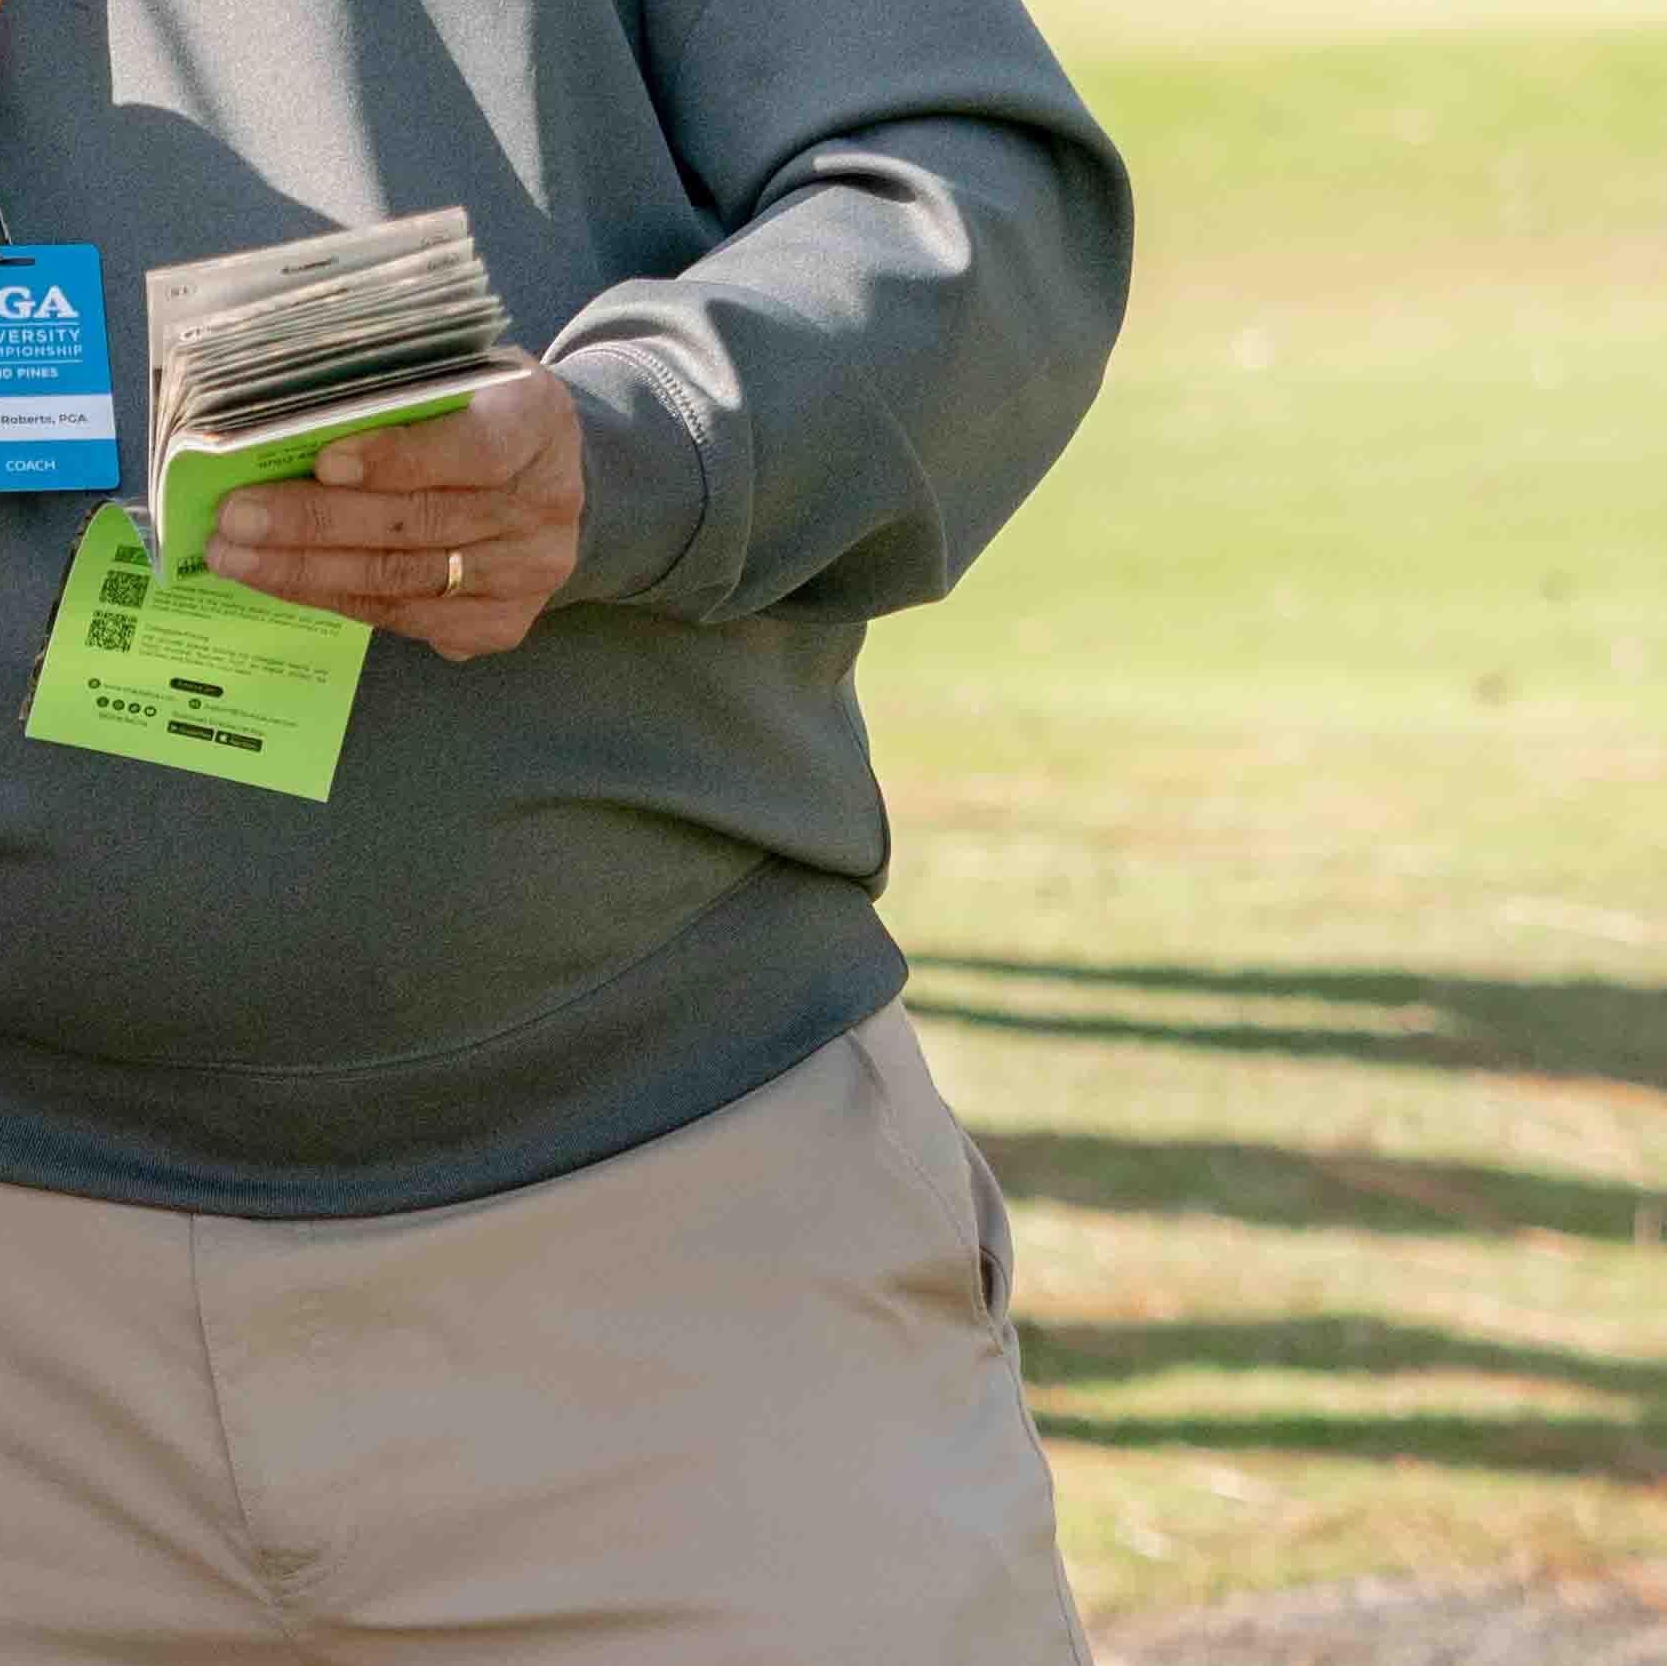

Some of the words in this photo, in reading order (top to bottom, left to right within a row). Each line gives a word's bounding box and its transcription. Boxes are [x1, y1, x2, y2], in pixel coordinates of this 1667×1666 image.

[17, 366, 59, 379] PINES
[0, 414, 56, 426] Roberts,
[59, 413, 87, 424] PGA
[5, 460, 56, 472] COACH
